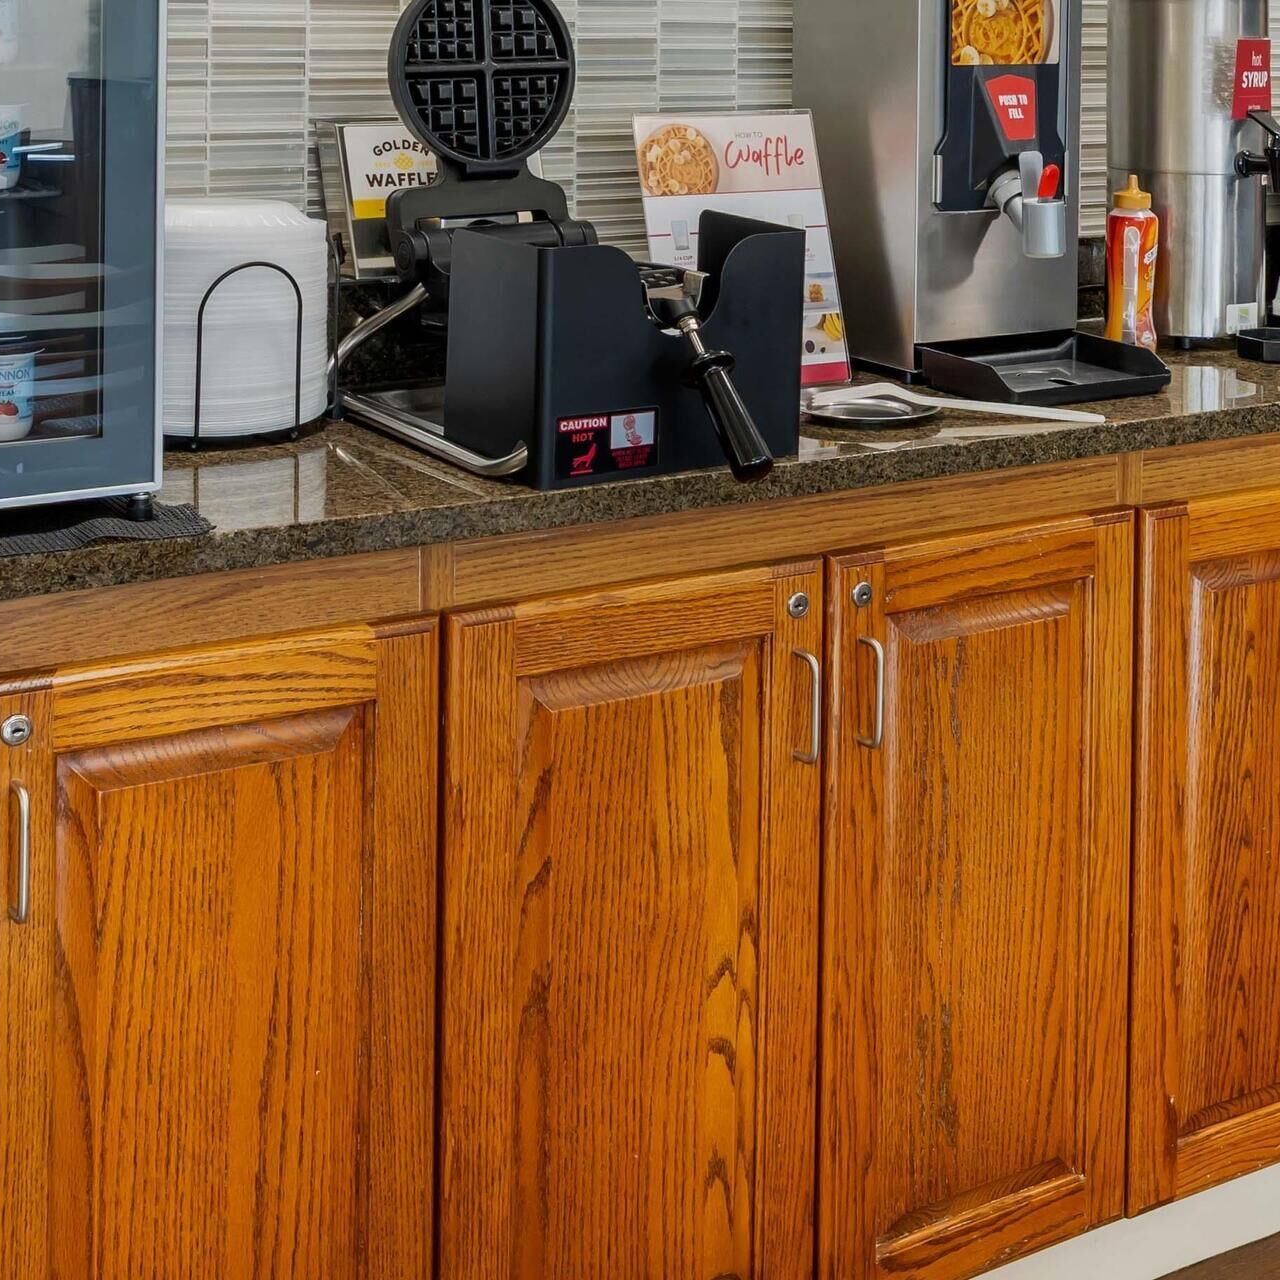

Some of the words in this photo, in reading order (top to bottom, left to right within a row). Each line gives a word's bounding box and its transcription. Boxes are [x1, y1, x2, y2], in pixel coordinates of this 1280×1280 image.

[1251, 50, 1262, 67] hot
[1241, 71, 1269, 89] SYRUP
[998, 94, 1018, 106] PUSH
[1017, 94, 1029, 105] TO
[1008, 107, 1025, 120] FILL
[735, 131, 752, 139] HOW
[372, 139, 430, 157] GOLDEN
[560, 417, 607, 431] CAUTION
[572, 432, 594, 442] HOT
